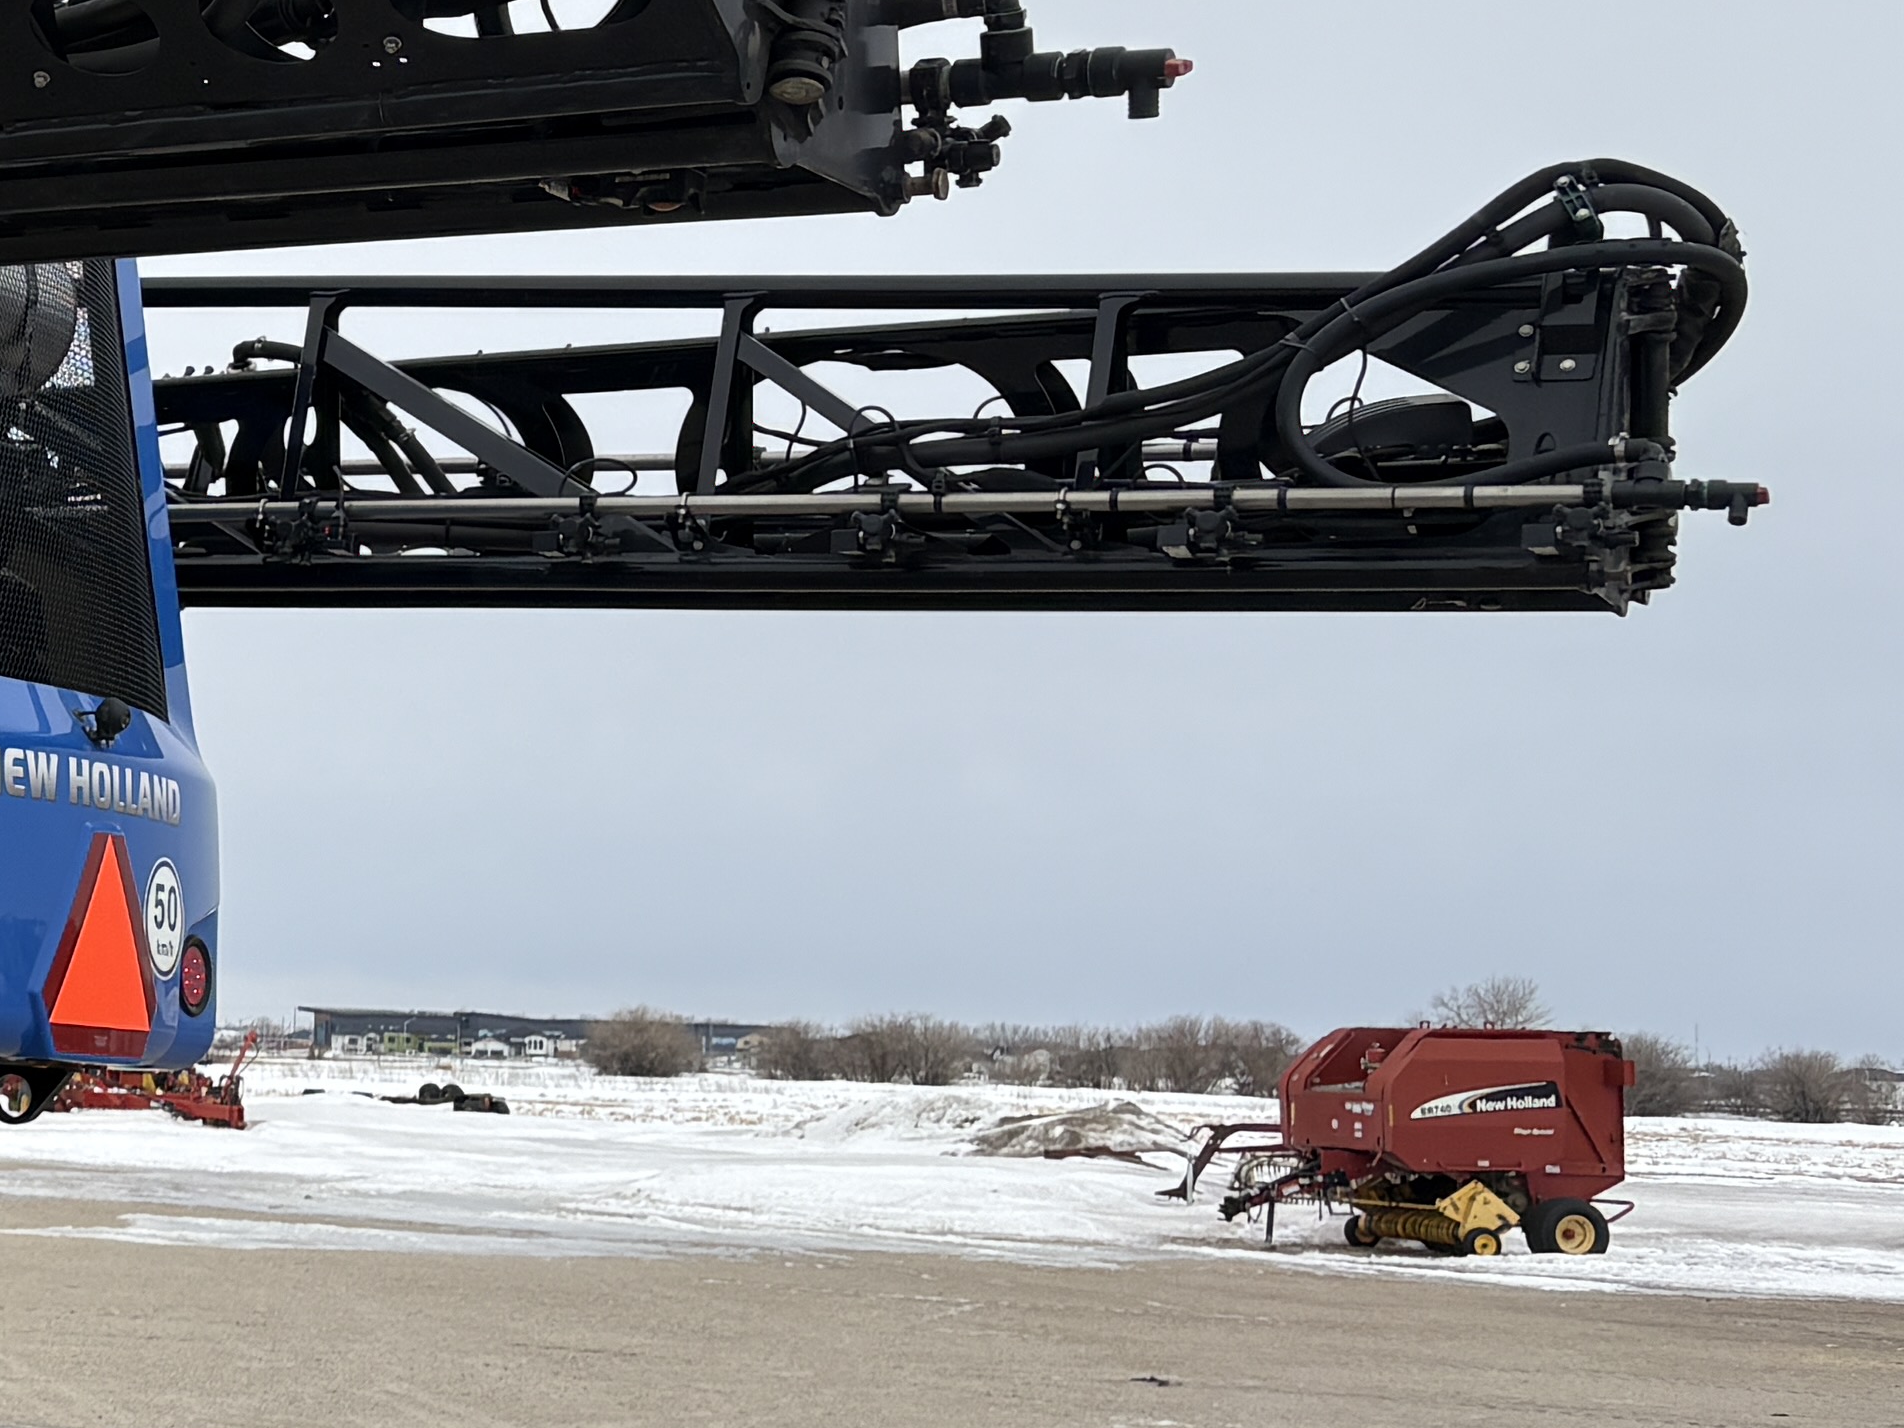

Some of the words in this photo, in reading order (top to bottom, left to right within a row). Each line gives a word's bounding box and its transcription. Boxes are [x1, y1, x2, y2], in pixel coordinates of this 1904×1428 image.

[68, 756, 181, 826] HOLLAND
[154, 883, 177, 932] 50
[1476, 1099, 1504, 1112] New
[1507, 1095, 1556, 1110] Holland
